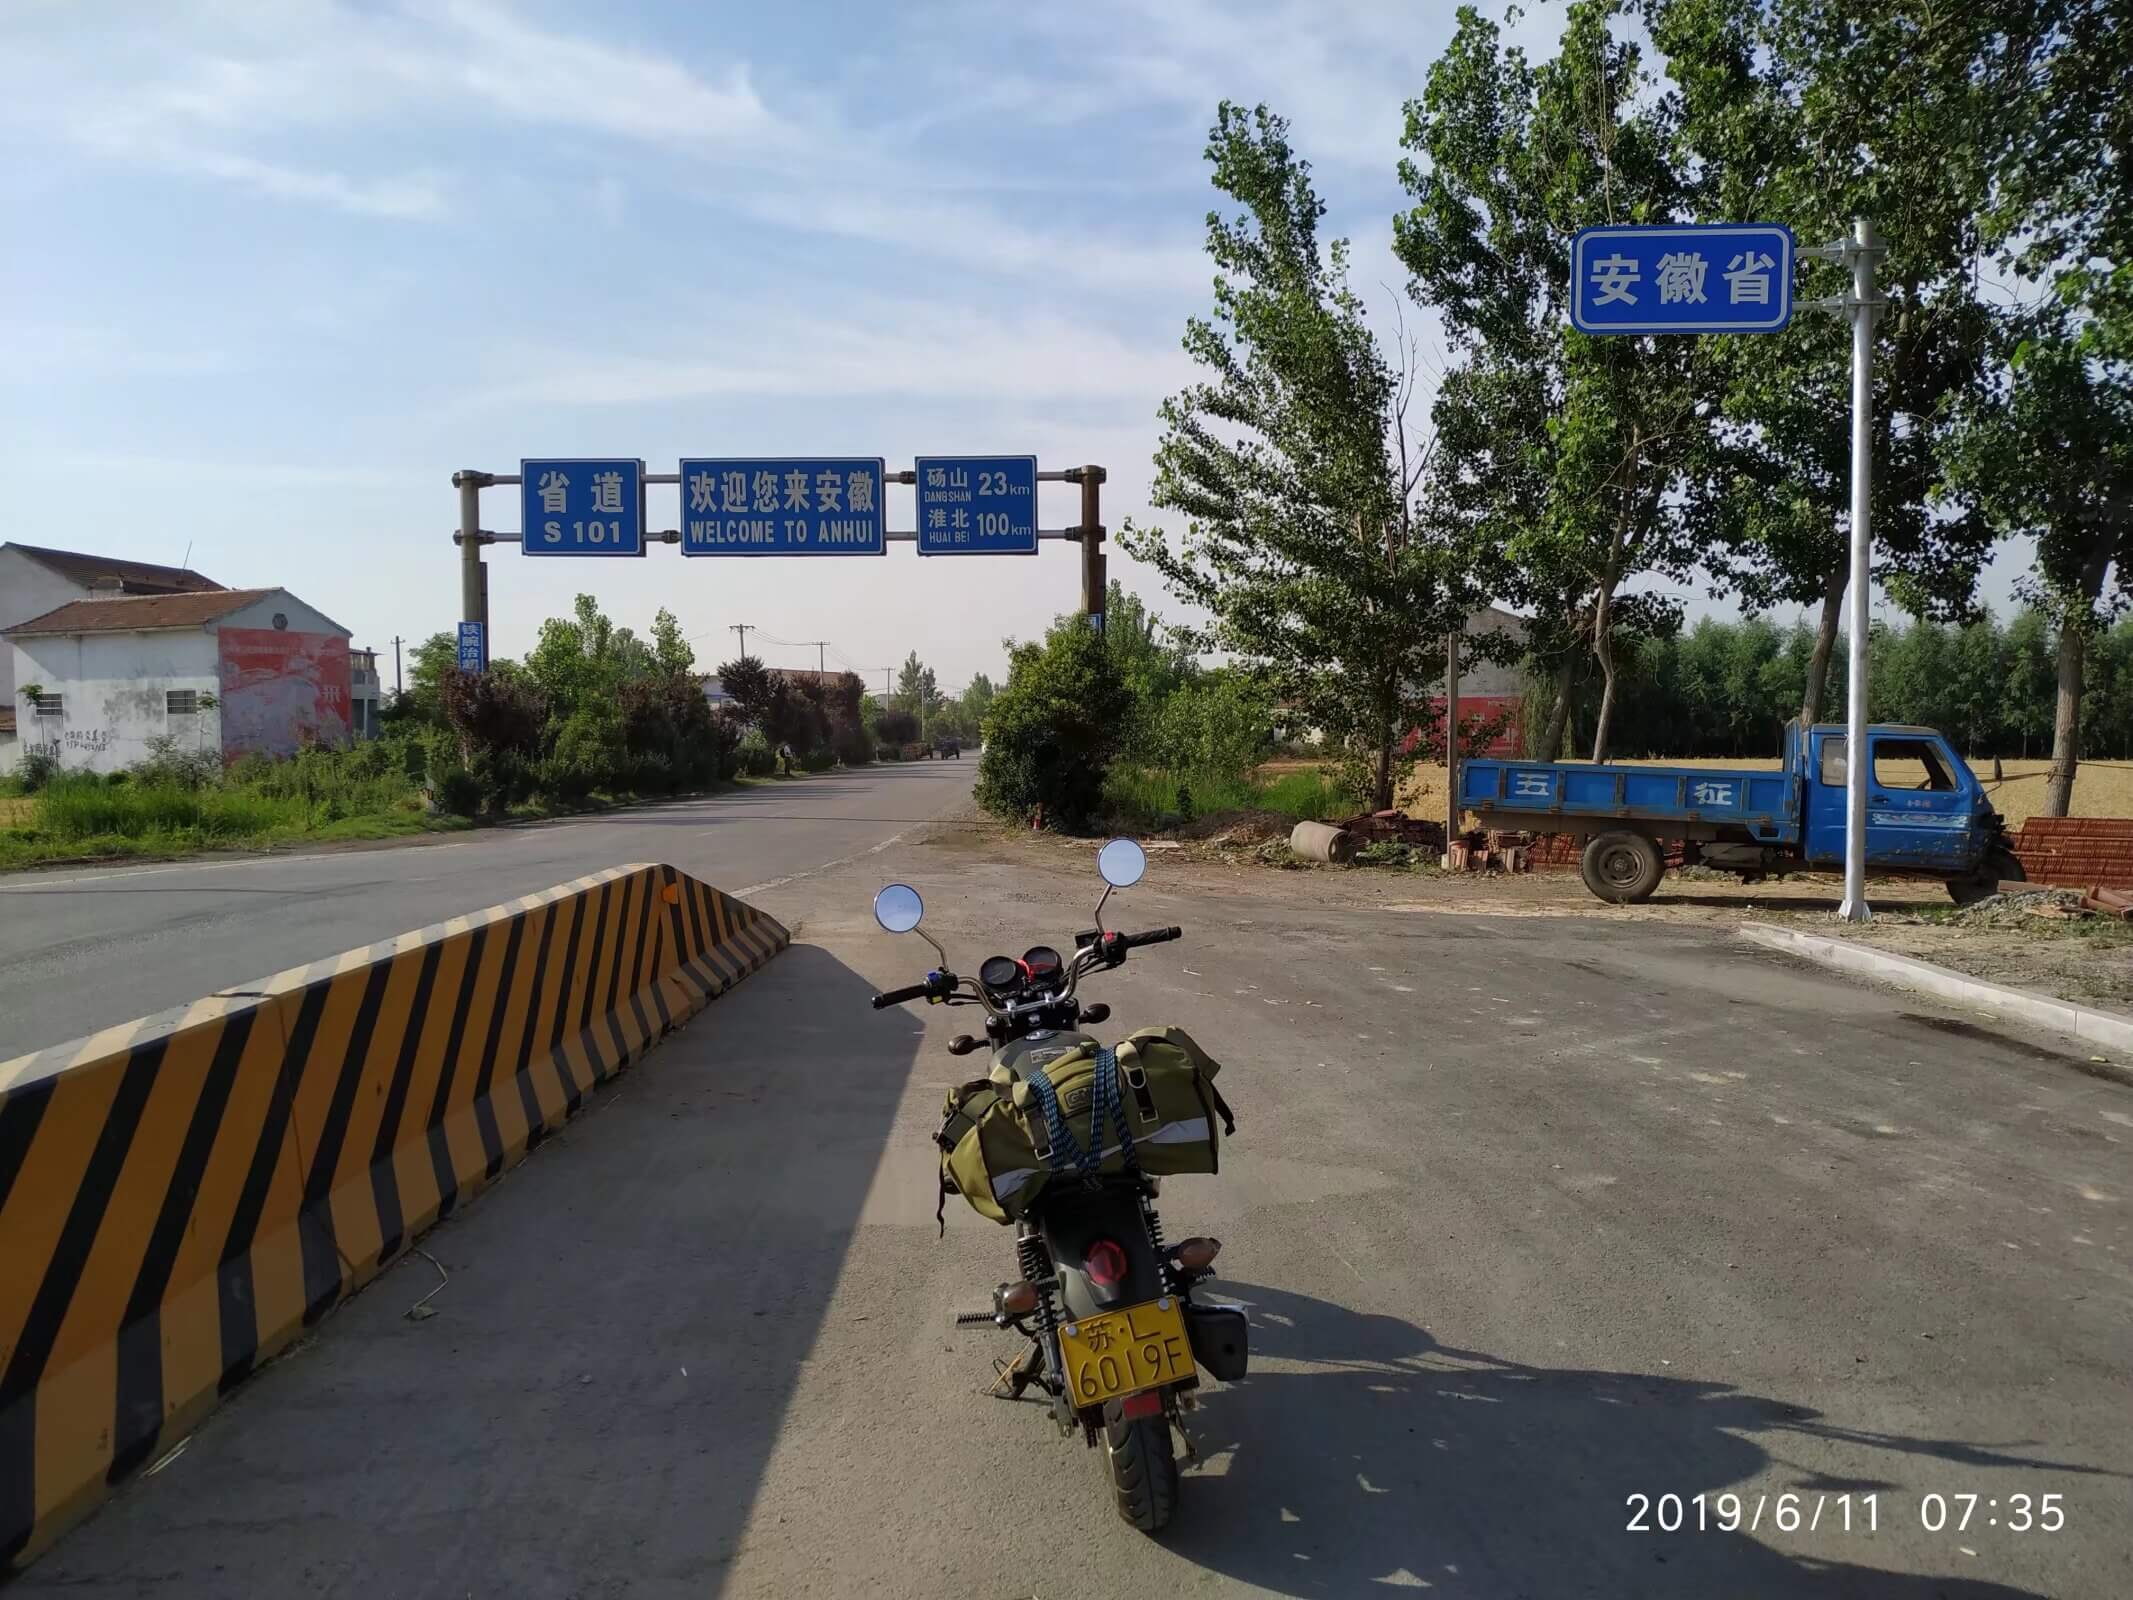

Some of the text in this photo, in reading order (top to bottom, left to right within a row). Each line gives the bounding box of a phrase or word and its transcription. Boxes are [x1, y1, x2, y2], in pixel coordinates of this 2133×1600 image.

[1590, 251, 1776, 306] 安徽省
[537, 470, 625, 513] 省道
[688, 468, 875, 513] 欢迎您来安徽
[926, 467, 969, 488] 砀山
[690, 519, 873, 544] WELCOME TO ANHUI
[927, 508, 971, 529] 淮北
[1079, 1336, 1183, 1398] 6019F
